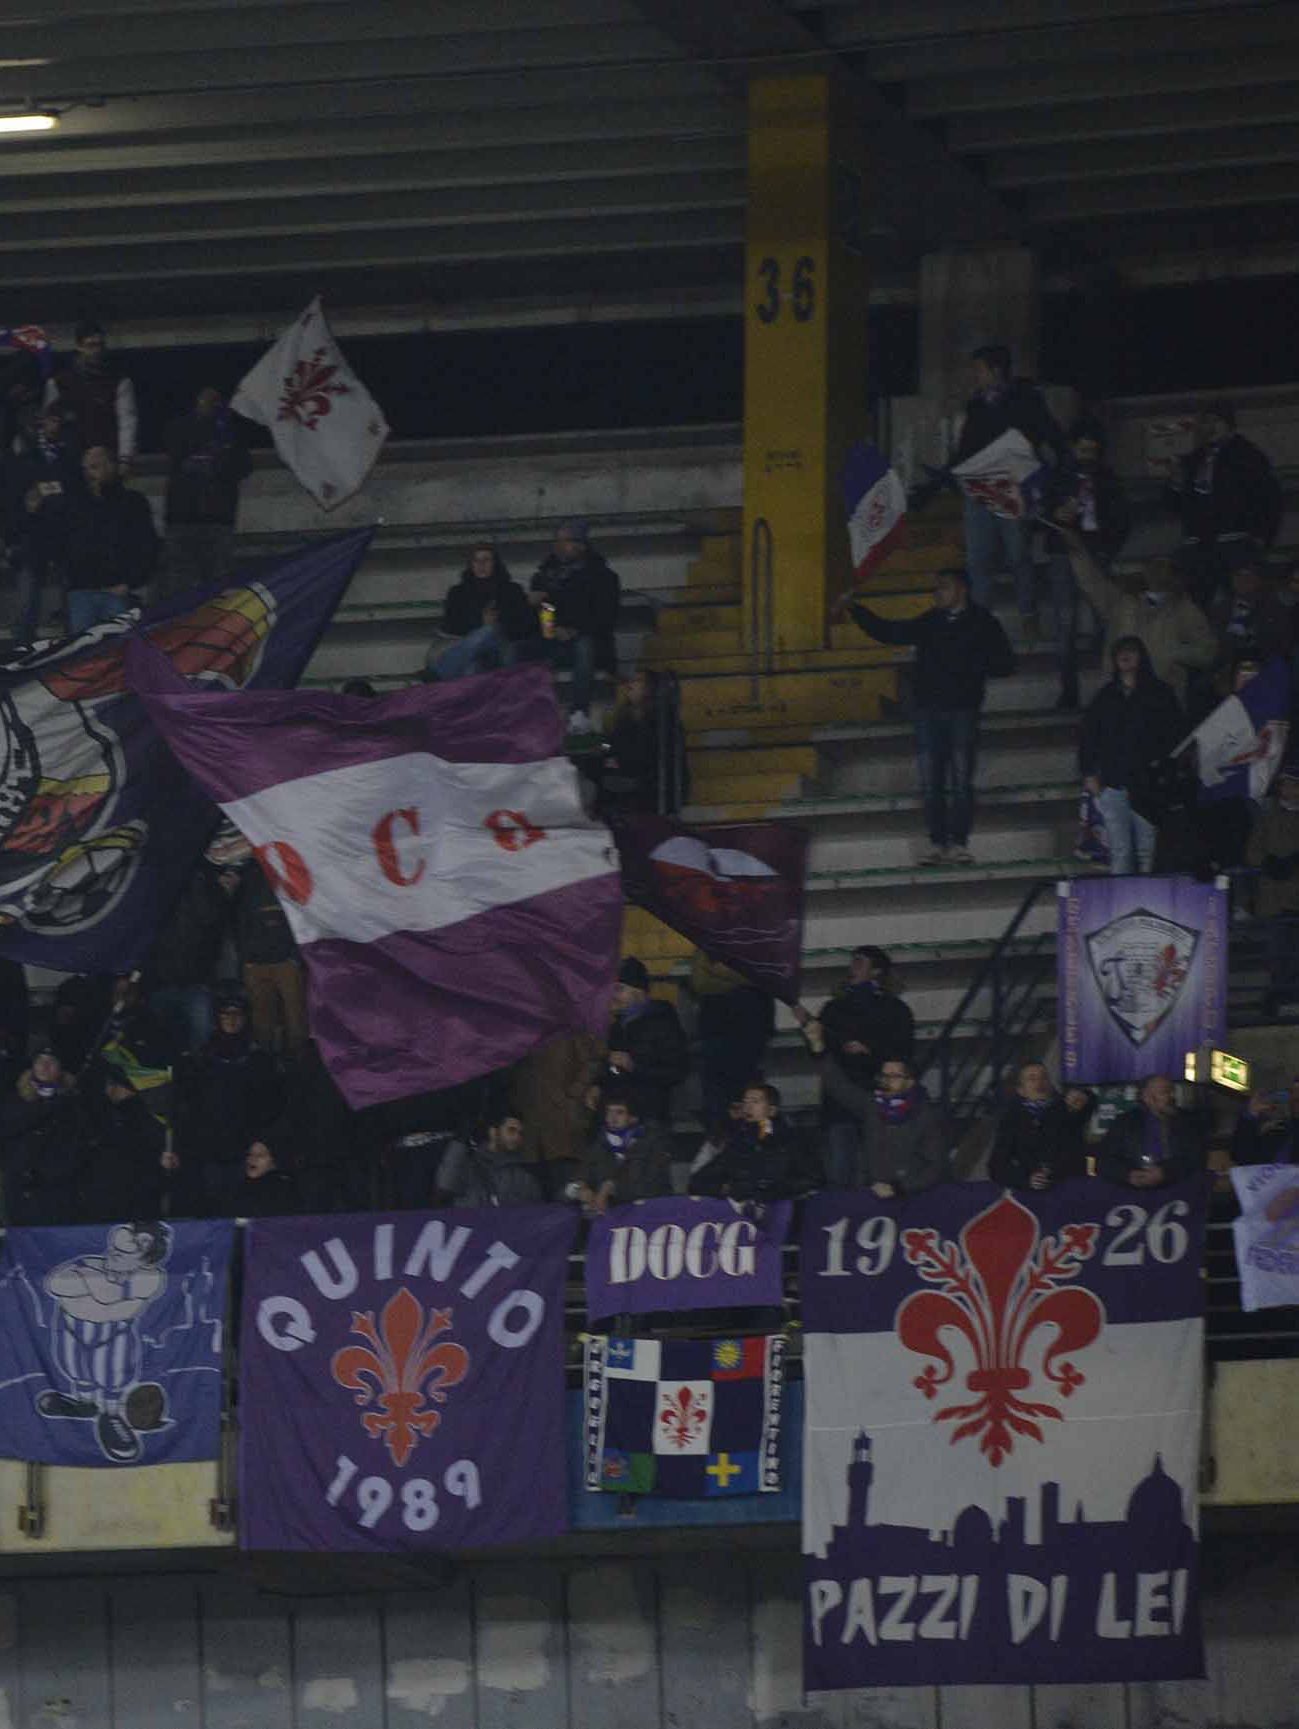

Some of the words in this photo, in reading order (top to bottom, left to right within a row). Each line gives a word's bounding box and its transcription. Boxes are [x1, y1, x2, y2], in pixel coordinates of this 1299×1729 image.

[757, 256, 814, 323] 36
[608, 1220, 758, 1285] DOCG
[818, 1216, 898, 1277] 19
[1102, 1199, 1190, 1267] 26
[255, 1220, 546, 1352] QUINTO
[326, 1455, 482, 1532] 1989
[810, 1573, 980, 1647] PAZZI
[1007, 1573, 1069, 1646] DI
[1096, 1568, 1189, 1640] LEI
